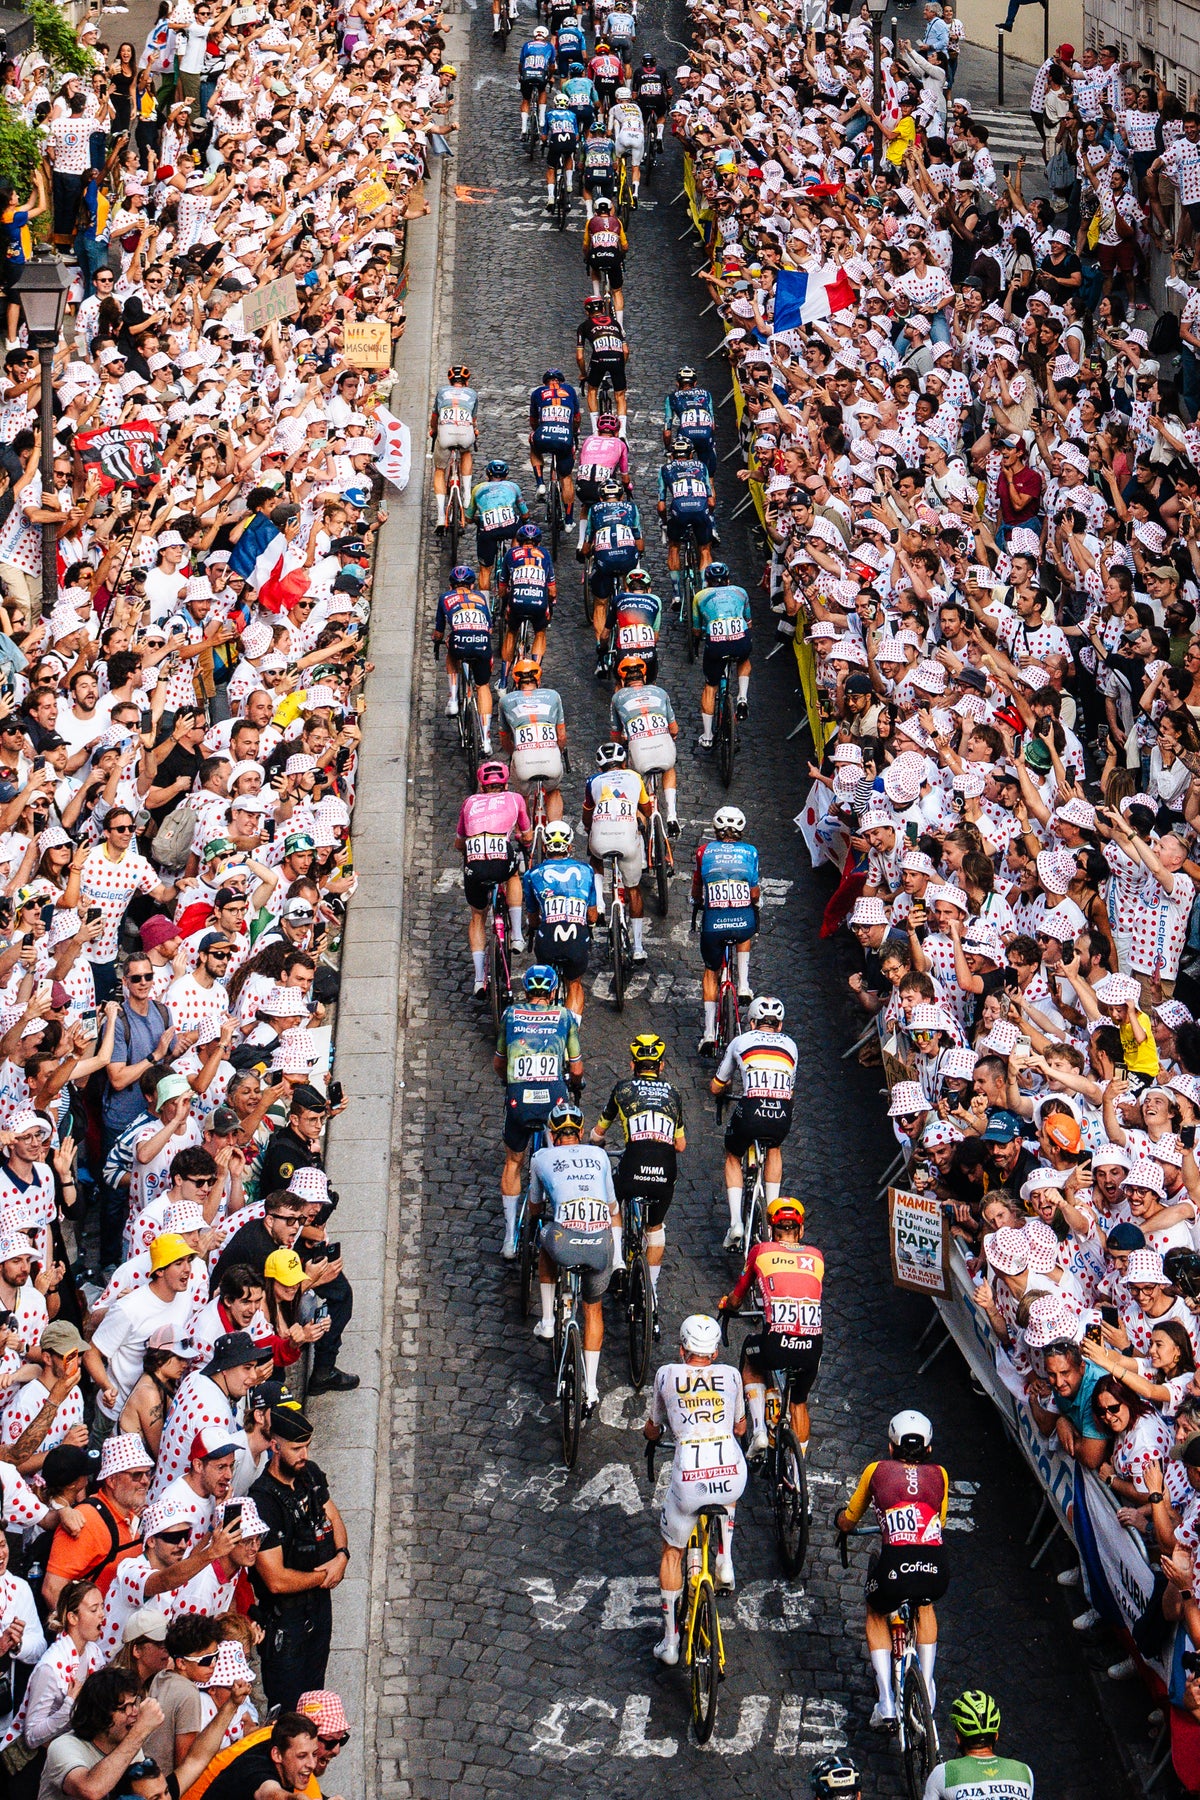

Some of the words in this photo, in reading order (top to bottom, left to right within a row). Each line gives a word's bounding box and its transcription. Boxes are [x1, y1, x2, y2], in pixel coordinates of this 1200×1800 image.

[442, 408, 455, 420] 82
[458, 409, 470, 421] 82
[548, 425, 571, 435] raisin
[484, 511, 496, 526] 67
[501, 508, 511, 521] 67
[519, 586, 544, 599] raisin
[453, 609, 470, 625] 218
[642, 626, 655, 641] 51
[712, 621, 725, 636] 63
[730, 619, 742, 634] 63
[461, 634, 488, 644] raisin
[623, 627, 635, 643] 51
[631, 718, 646, 735] 83
[651, 715, 666, 729] 83
[519, 728, 533, 744] 85
[542, 726, 556, 741] 85
[630, 731, 651, 742] VELUX
[517, 741, 537, 752] VELUX
[596, 801, 611, 816] 81
[620, 801, 633, 817] 81
[467, 838, 481, 854] 46
[489, 838, 504, 853] 46
[709, 883, 729, 902] 185
[730, 882, 750, 901] 185
[545, 898, 566, 917] 147
[713, 920, 748, 930] DISTRICLOS
[1156, 905, 1169, 955] E.Leclerc
[514, 1014, 560, 1023] SOUDAL
[518, 1057, 534, 1078] 92
[539, 1056, 556, 1077] 92
[631, 1079, 671, 1090] VISMA
[747, 1070, 769, 1090] 114
[773, 1071, 791, 1091] 114
[634, 1113, 648, 1132] 17
[659, 1114, 673, 1132] 17
[571, 1158, 602, 1172] UBS
[640, 1165, 665, 1176] VISMA
[566, 1173, 596, 1182] AMACX
[564, 1201, 586, 1221] 176
[897, 1193, 941, 1217] MAMIE,
[896, 1215, 914, 1230] TU
[897, 1208, 904, 1217] IL
[905, 1210, 924, 1222] FAUT
[925, 1216, 940, 1227] QUE
[562, 1219, 587, 1232] VELUX
[897, 1229, 941, 1251] PAPY
[771, 1257, 795, 1266] Uno
[898, 1263, 905, 1271] IL
[906, 1266, 917, 1275] VA
[918, 1269, 943, 1281] RATER
[771, 1303, 798, 1325] 125
[770, 1324, 796, 1335] VELUX
[780, 1336, 813, 1351] bāma
[675, 1375, 725, 1396] UAE
[677, 1396, 726, 1410] Emirates
[681, 1410, 726, 1426] XRG
[690, 1444, 701, 1470] 7
[713, 1441, 724, 1467] 7
[684, 1468, 706, 1483] VELU
[707, 1466, 738, 1481] VELUX
[708, 1480, 733, 1496] IHC
[887, 1508, 917, 1535] 168
[890, 1533, 918, 1546] VELUX
[899, 1562, 939, 1577] Cofidis
[528, 1693, 850, 1760] CLUB
[956, 1787, 986, 1800] CAJA
[989, 1784, 1033, 1800] RURAL
